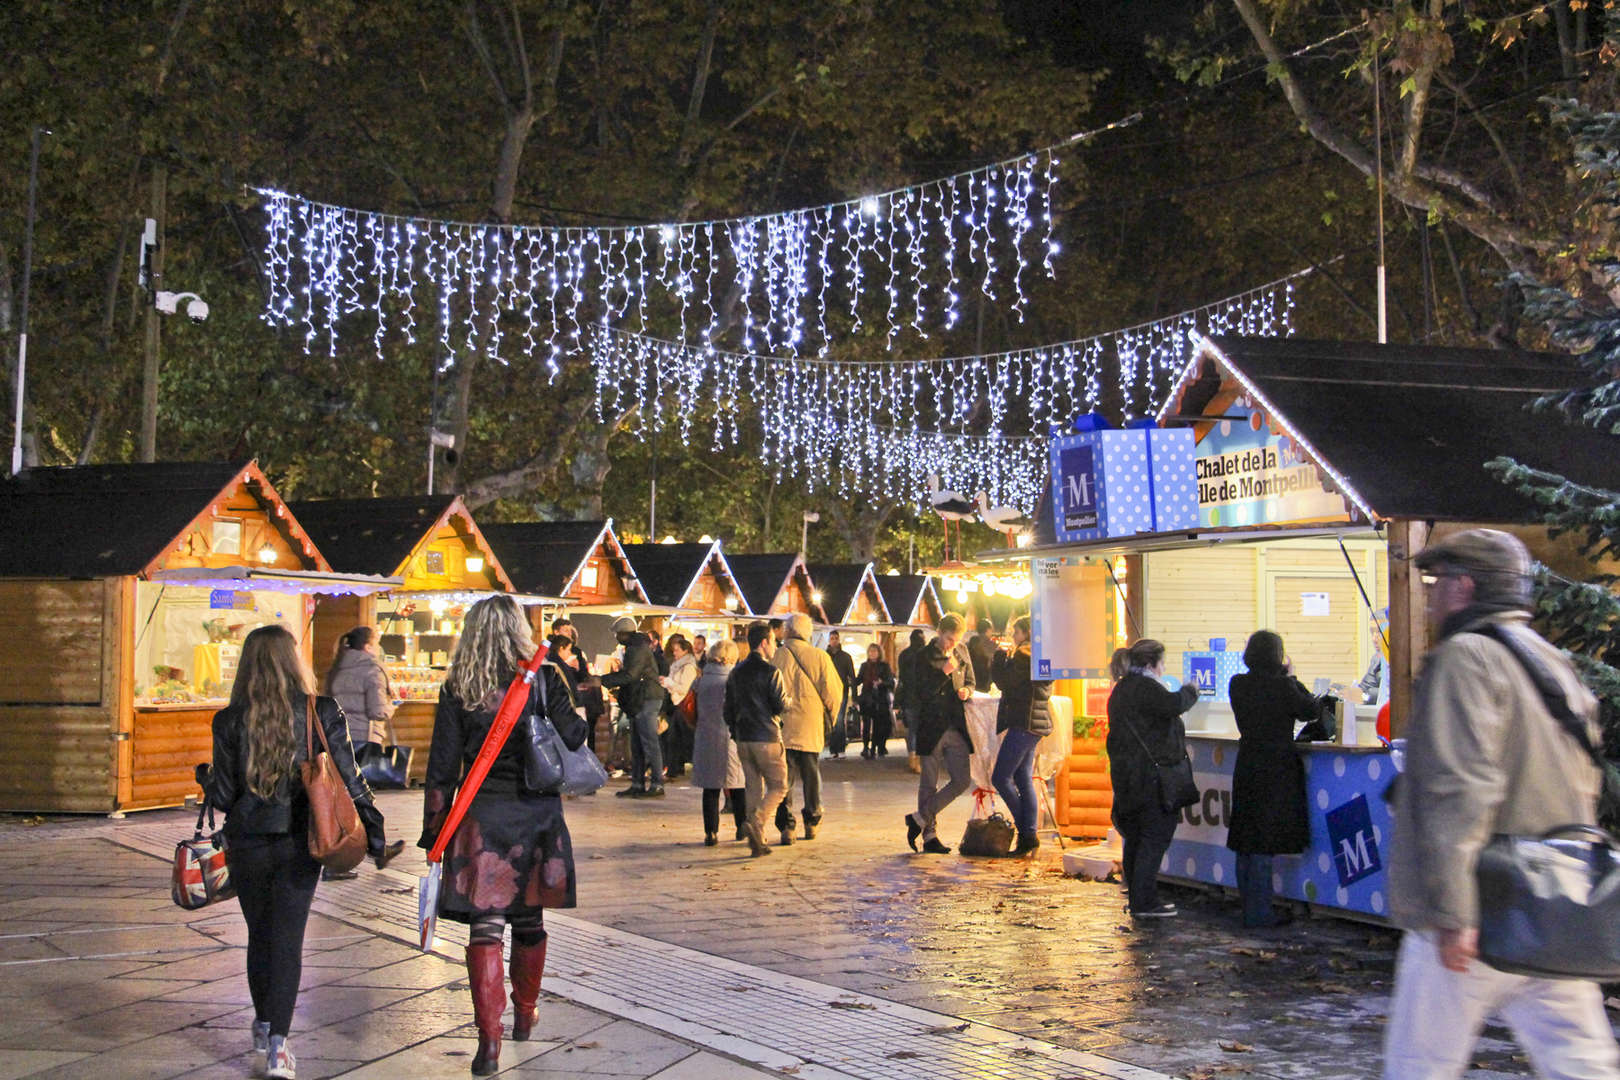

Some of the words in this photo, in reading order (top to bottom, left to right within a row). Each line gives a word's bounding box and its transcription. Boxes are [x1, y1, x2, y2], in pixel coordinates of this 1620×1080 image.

[1196, 455, 1240, 480] Chalet
[1242, 451, 1260, 473] de
[1262, 448, 1276, 468] la
[1067, 473, 1091, 507] M
[1198, 483, 1217, 503] lle
[1219, 480, 1237, 501] de
[1040, 664, 1049, 673] M
[1195, 669, 1212, 686] M
[1339, 830, 1374, 878] M
